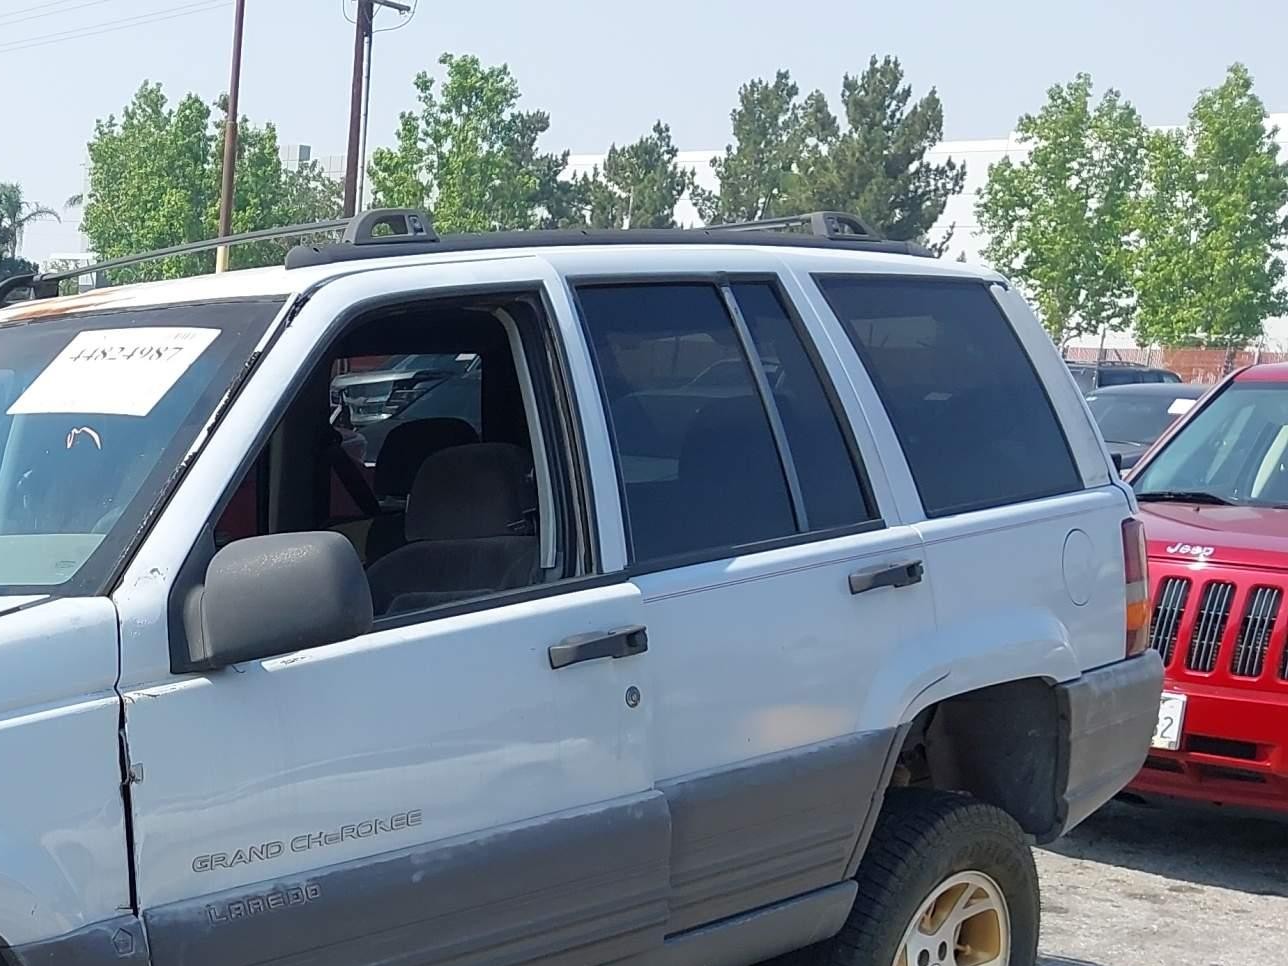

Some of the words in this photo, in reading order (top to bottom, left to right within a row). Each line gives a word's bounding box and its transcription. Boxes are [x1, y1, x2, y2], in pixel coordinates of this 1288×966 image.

[1165, 542, 1215, 560] Jeep
[191, 840, 285, 873] GRAND
[290, 808, 423, 853] CHEROKEE
[205, 882, 322, 924] LAREDO
